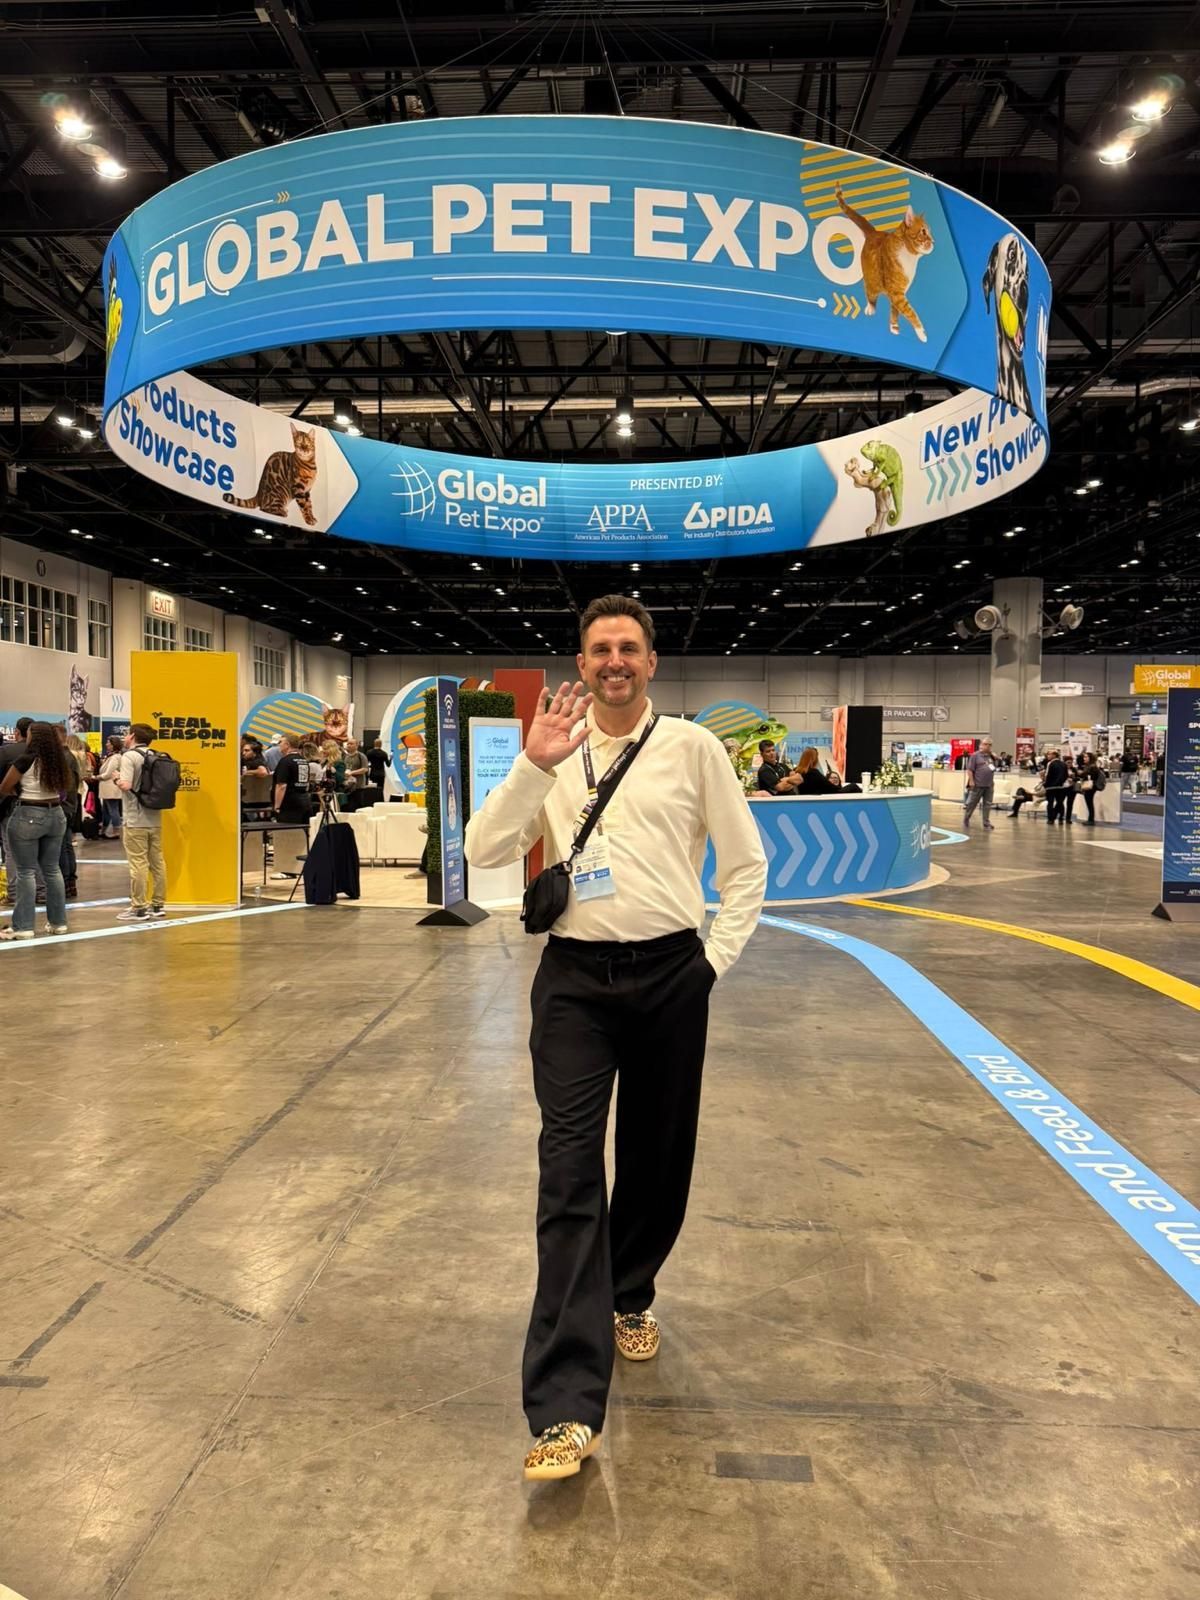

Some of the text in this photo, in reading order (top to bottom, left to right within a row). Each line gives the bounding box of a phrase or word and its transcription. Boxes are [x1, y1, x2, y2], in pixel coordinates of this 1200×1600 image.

[148, 183, 866, 316] GLOBAL PET EXPO
[120, 399, 234, 491] Showcase
[924, 412, 983, 463] New
[438, 468, 546, 507] Global
[630, 474, 724, 491] PRESENTED BY:
[445, 501, 481, 529] Pet
[586, 504, 654, 532] APPA
[746, 526, 776, 534] Association
[154, 596, 172, 614] EXIT
[1155, 670, 1192, 680] Global
[159, 717, 211, 728] REAL
[965, 1054, 1034, 1085] Bird
[1004, 1088, 1050, 1101] &
[1015, 1104, 1113, 1156] Feed
[1074, 1162, 1177, 1213] and
